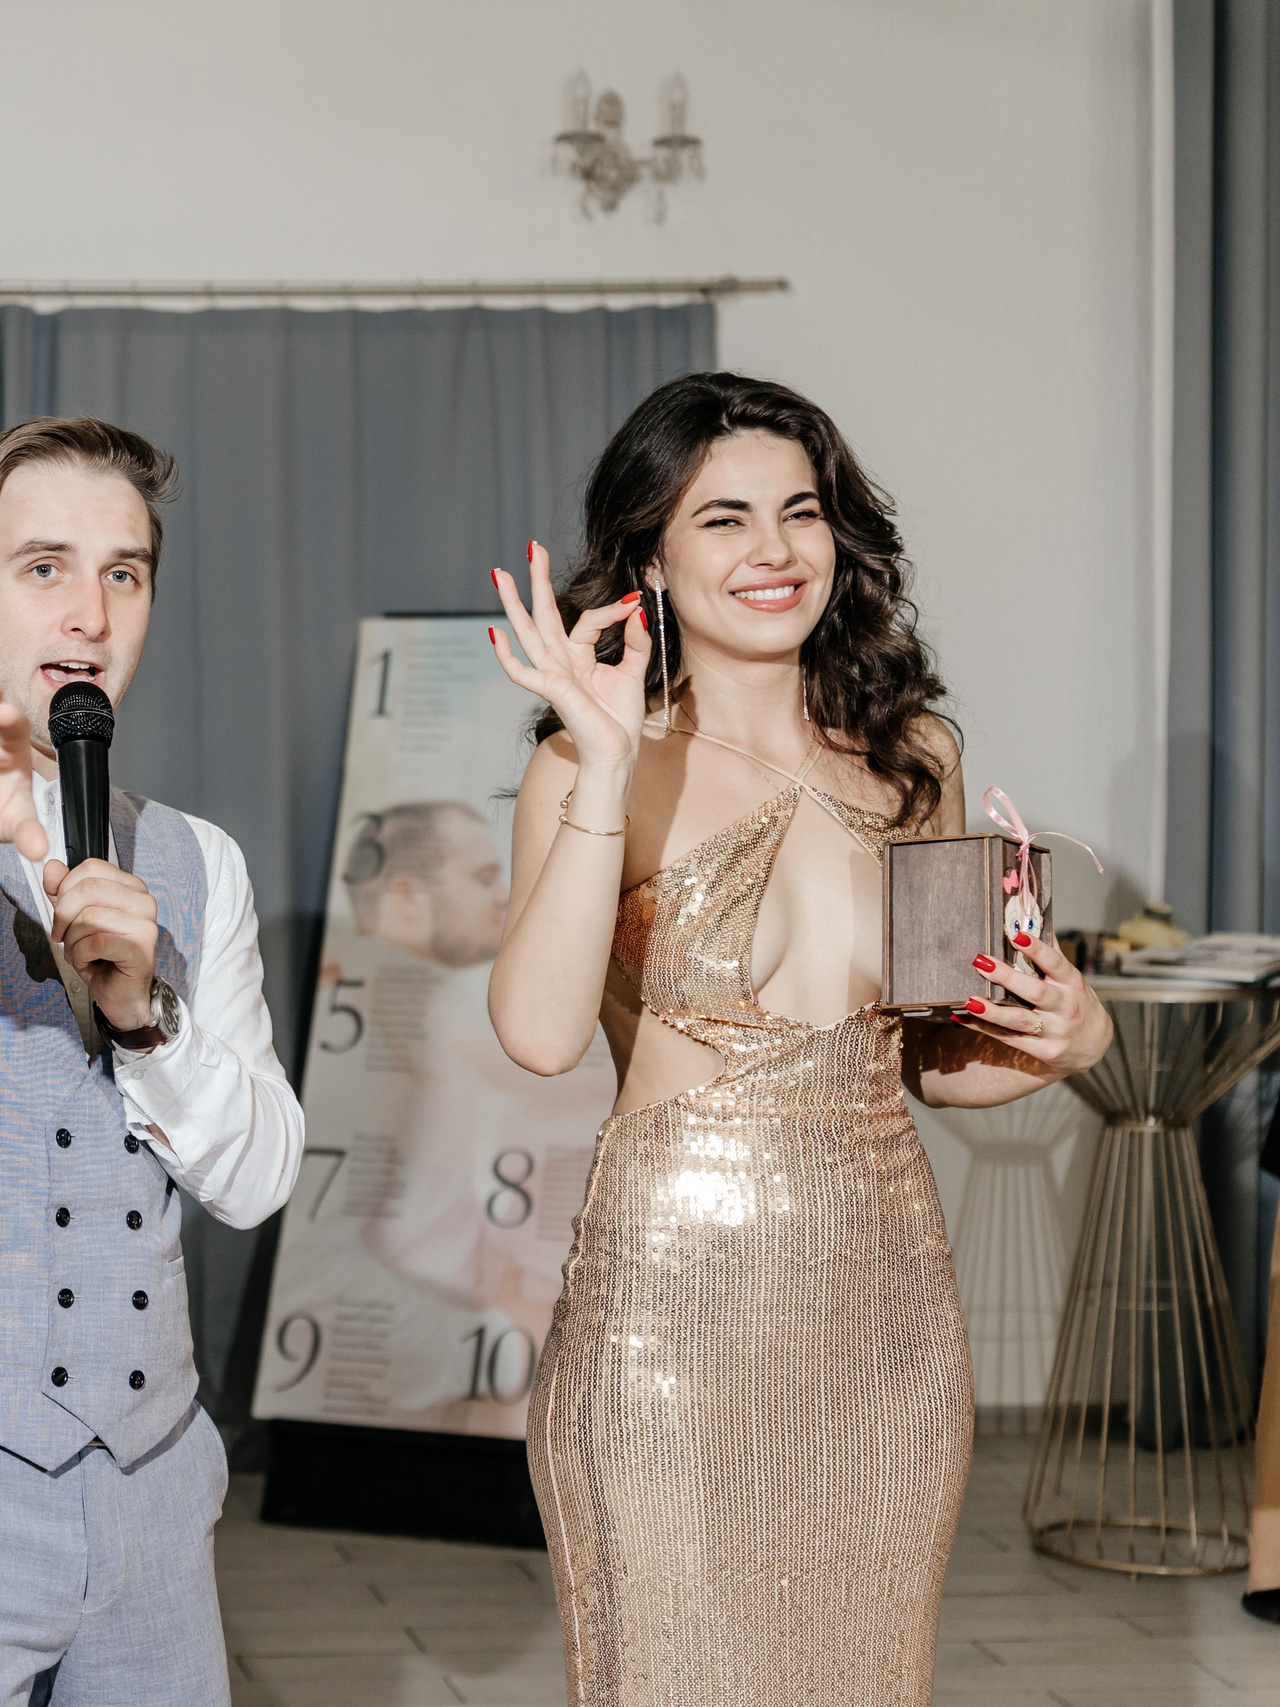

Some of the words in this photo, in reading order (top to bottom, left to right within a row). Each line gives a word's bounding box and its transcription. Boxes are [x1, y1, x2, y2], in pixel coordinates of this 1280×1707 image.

[368, 650, 392, 718] 1
[320, 979, 365, 1054] 5
[304, 1147, 347, 1223] 7
[486, 1147, 534, 1229] 8
[274, 1312, 323, 1394] 9
[459, 1325, 536, 1406] 10
